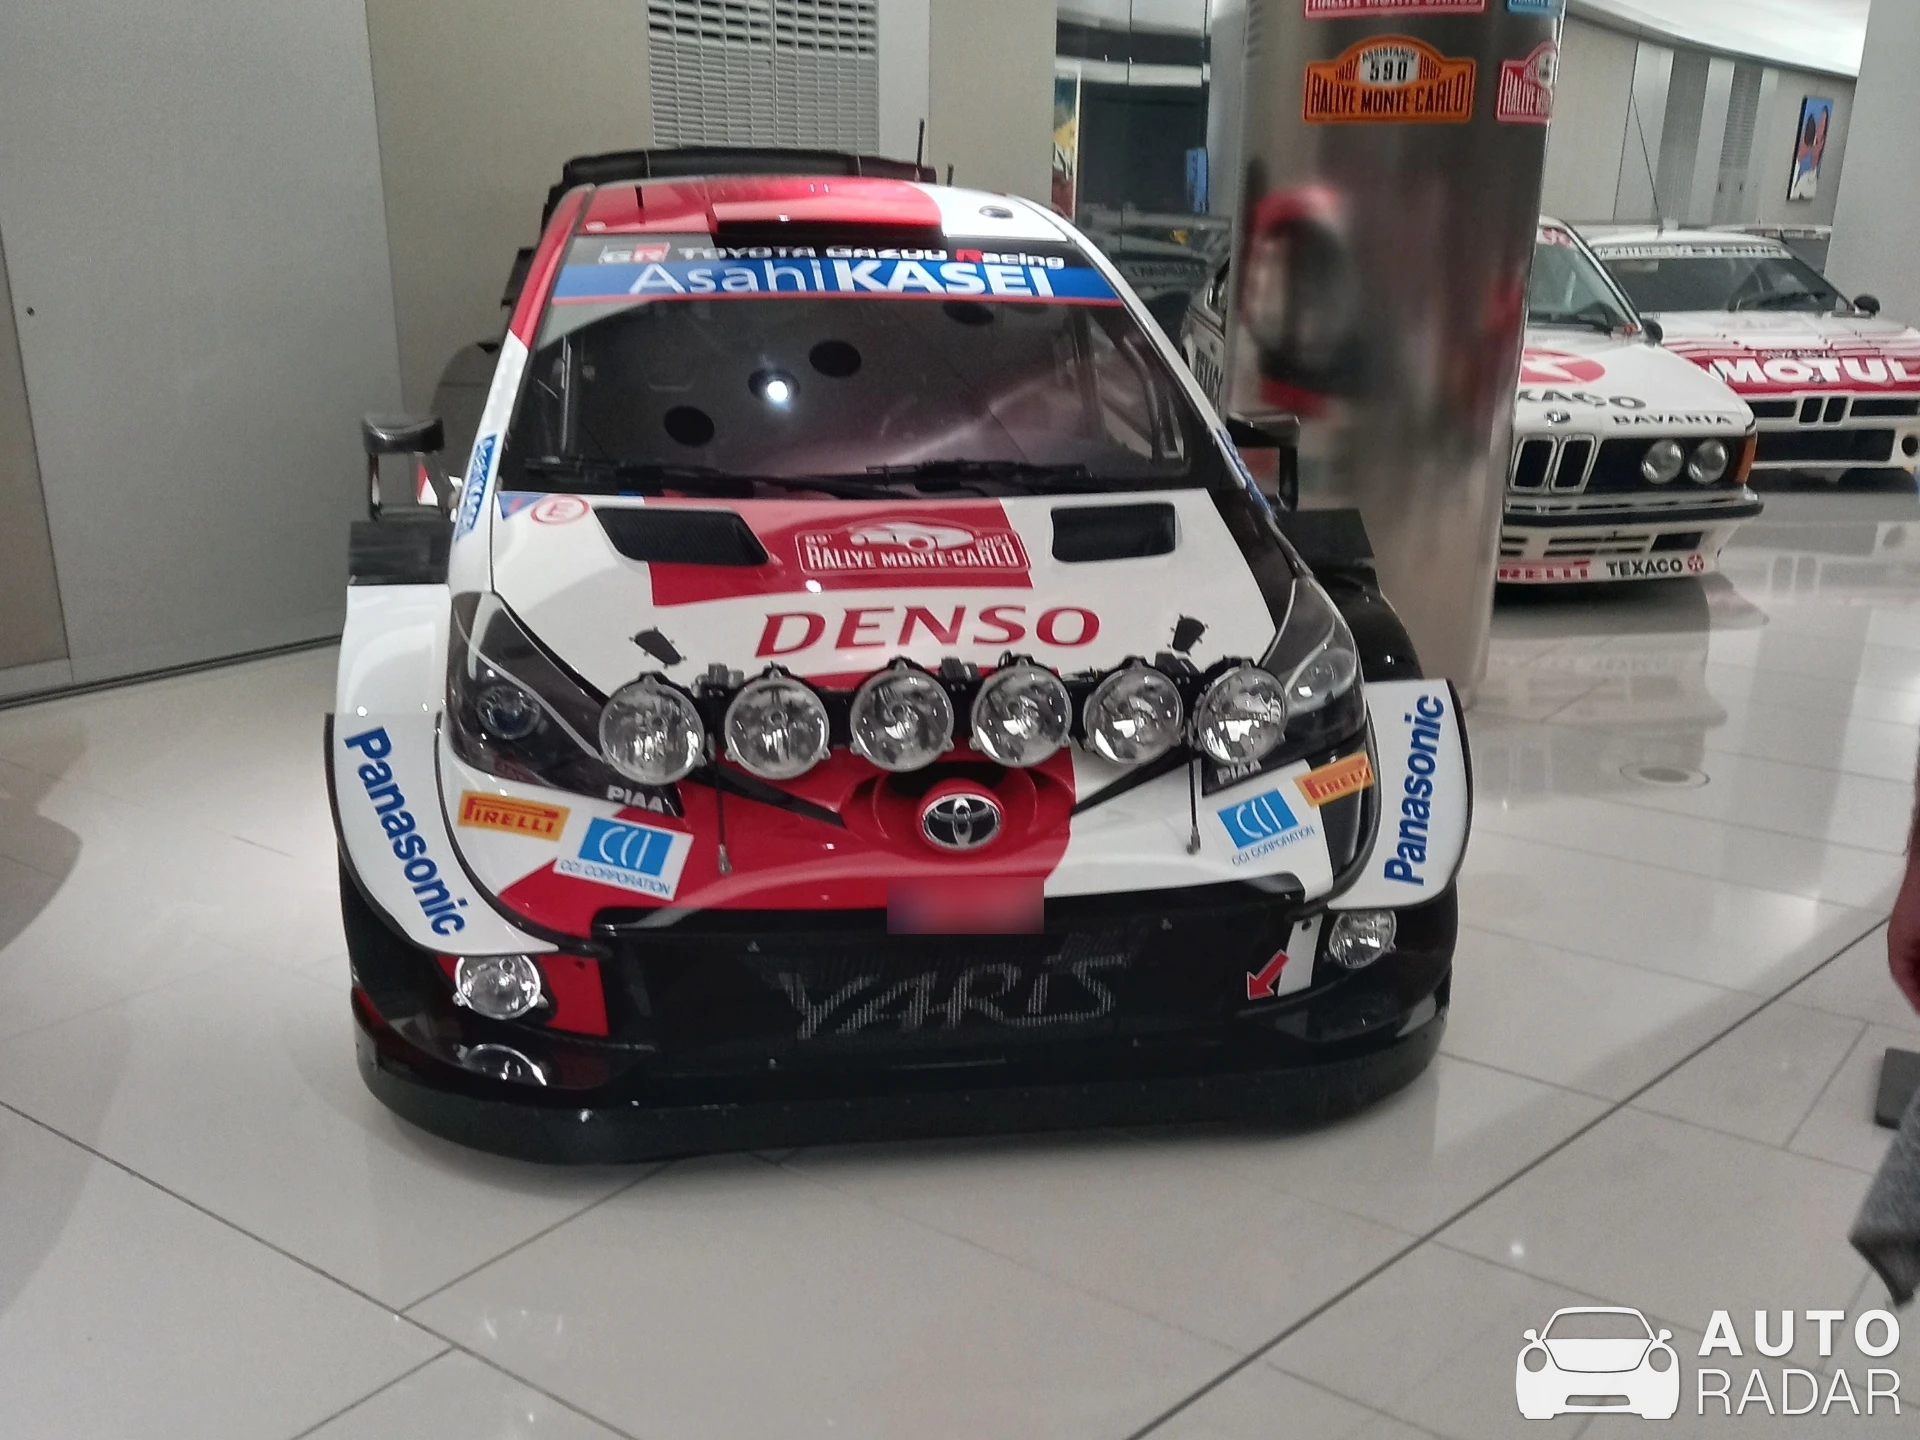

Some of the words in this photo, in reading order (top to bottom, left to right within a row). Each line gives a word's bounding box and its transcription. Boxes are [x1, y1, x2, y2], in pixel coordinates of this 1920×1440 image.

[1369, 61, 1408, 81] 590
[1310, 72, 1355, 114] RALLYE
[1360, 87, 1409, 114] MONTE
[1414, 71, 1466, 113] CARLO
[1502, 68, 1536, 115] RALLYE
[677, 246, 818, 261] TOYOTA
[955, 248, 1065, 269] Racing
[1709, 356, 1920, 385] MOTUL
[1612, 413, 1734, 426] BAVARIA
[805, 543, 877, 570] RALLYE
[1606, 558, 1684, 577] TEXACO
[754, 604, 1101, 659] DENSO
[1216, 759, 1262, 785] PIAA
[1303, 756, 1371, 800] PIRELLI
[1383, 694, 1445, 887] Panasonic
[463, 796, 560, 834] PIRELLI
[606, 784, 664, 813] PIAA
[343, 725, 469, 937] Panasonic
[1236, 796, 1282, 840] CCI
[598, 825, 652, 870] CCI
[1249, 825, 1316, 861] CORPORATION
[560, 859, 583, 874] CCI
[584, 864, 671, 895] CORPORATION
[778, 954, 1130, 1041] YARIS
